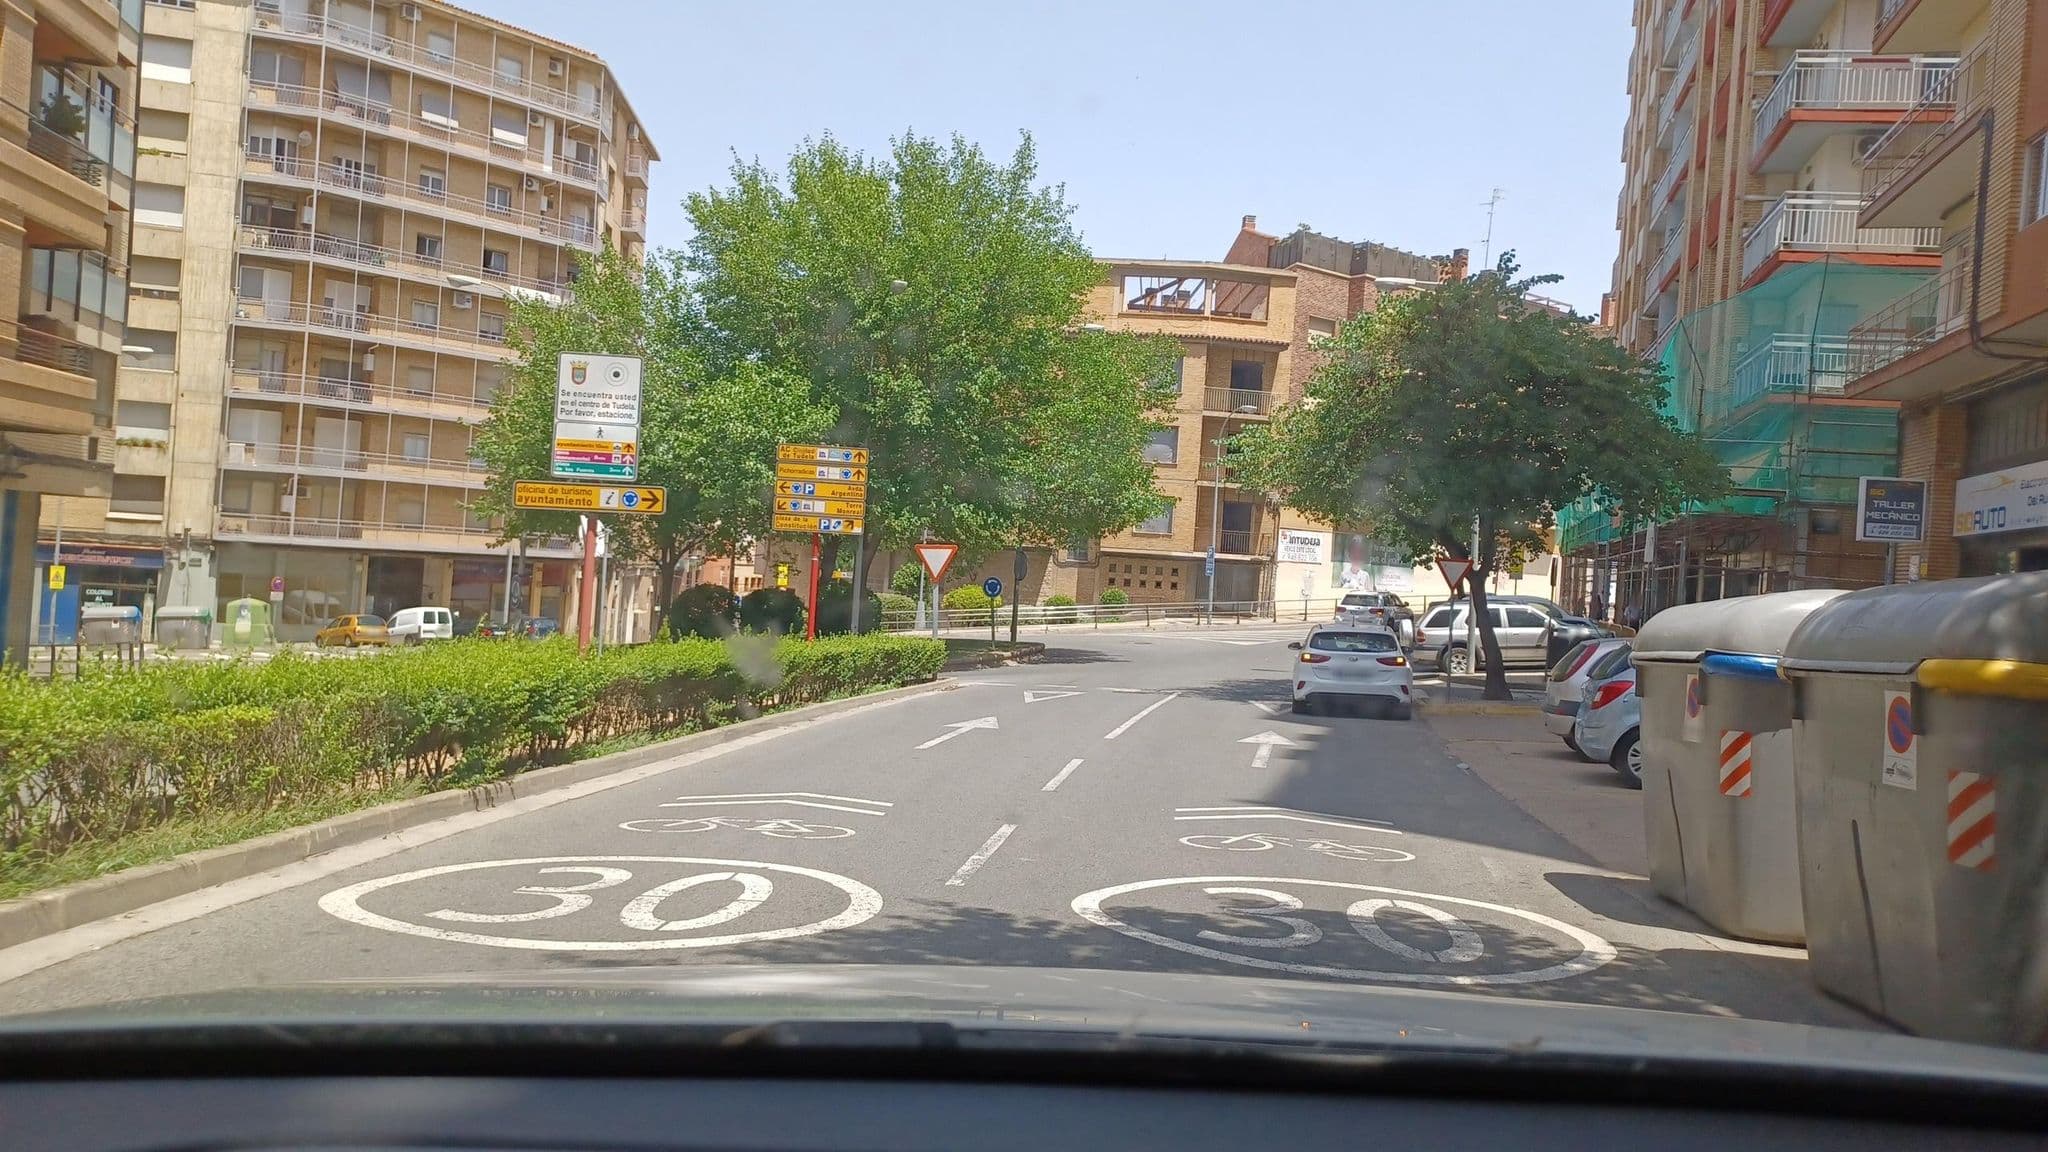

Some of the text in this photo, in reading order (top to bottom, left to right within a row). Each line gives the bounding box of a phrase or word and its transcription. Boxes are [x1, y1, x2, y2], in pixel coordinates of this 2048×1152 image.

[573, 391, 612, 399] encuentra
[575, 409, 596, 417] favor,
[597, 411, 635, 420] estacione.
[517, 485, 593, 496] oficina de turismo
[831, 490, 863, 498] Argentina
[517, 495, 593, 507] ayuntamiento
[1873, 500, 1915, 510] TALLER
[1866, 511, 1921, 522] MECÁNICO
[424, 866, 774, 931] 30
[1197, 887, 1485, 963] 30
